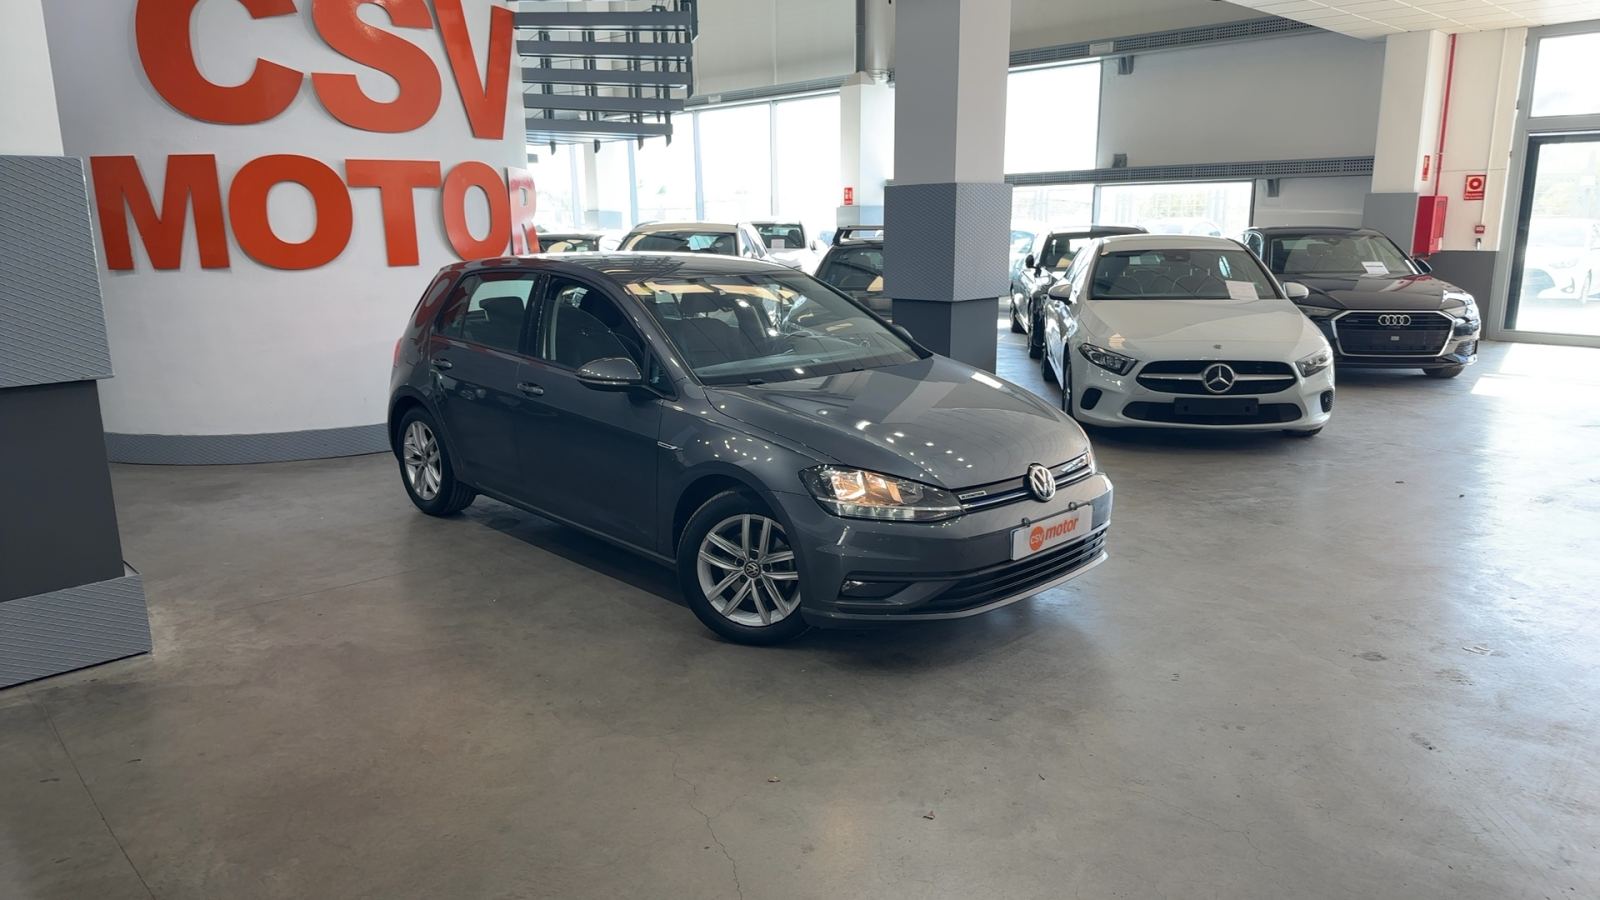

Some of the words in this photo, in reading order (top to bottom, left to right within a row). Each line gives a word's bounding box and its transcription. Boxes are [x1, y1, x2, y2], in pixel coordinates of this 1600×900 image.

[135, 0, 515, 140] CSV
[90, 153, 540, 271] MOTOR
[1045, 518, 1079, 541] motor
